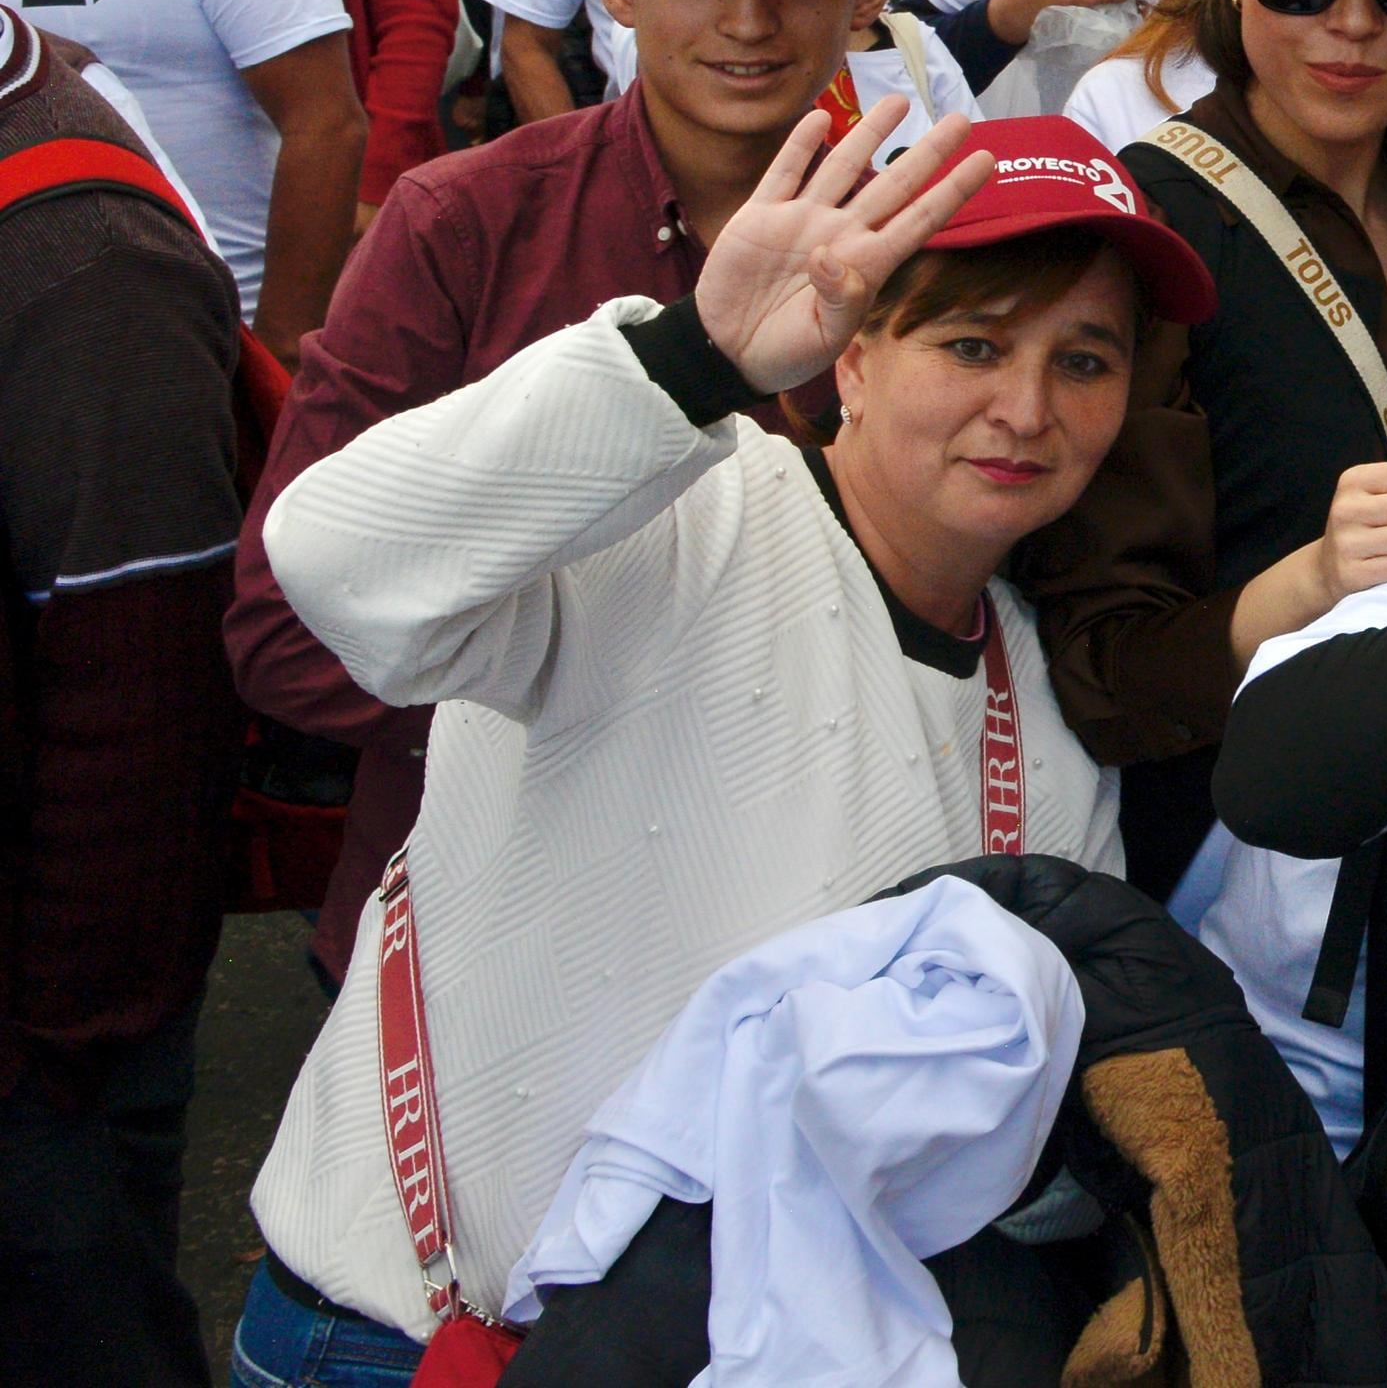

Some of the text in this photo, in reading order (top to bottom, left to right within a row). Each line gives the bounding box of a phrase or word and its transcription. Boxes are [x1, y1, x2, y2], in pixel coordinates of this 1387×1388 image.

[1157, 126, 1239, 185] TOUS
[995, 157, 1136, 214] ROYECTO 21
[1287, 237, 1352, 328] TOUS
